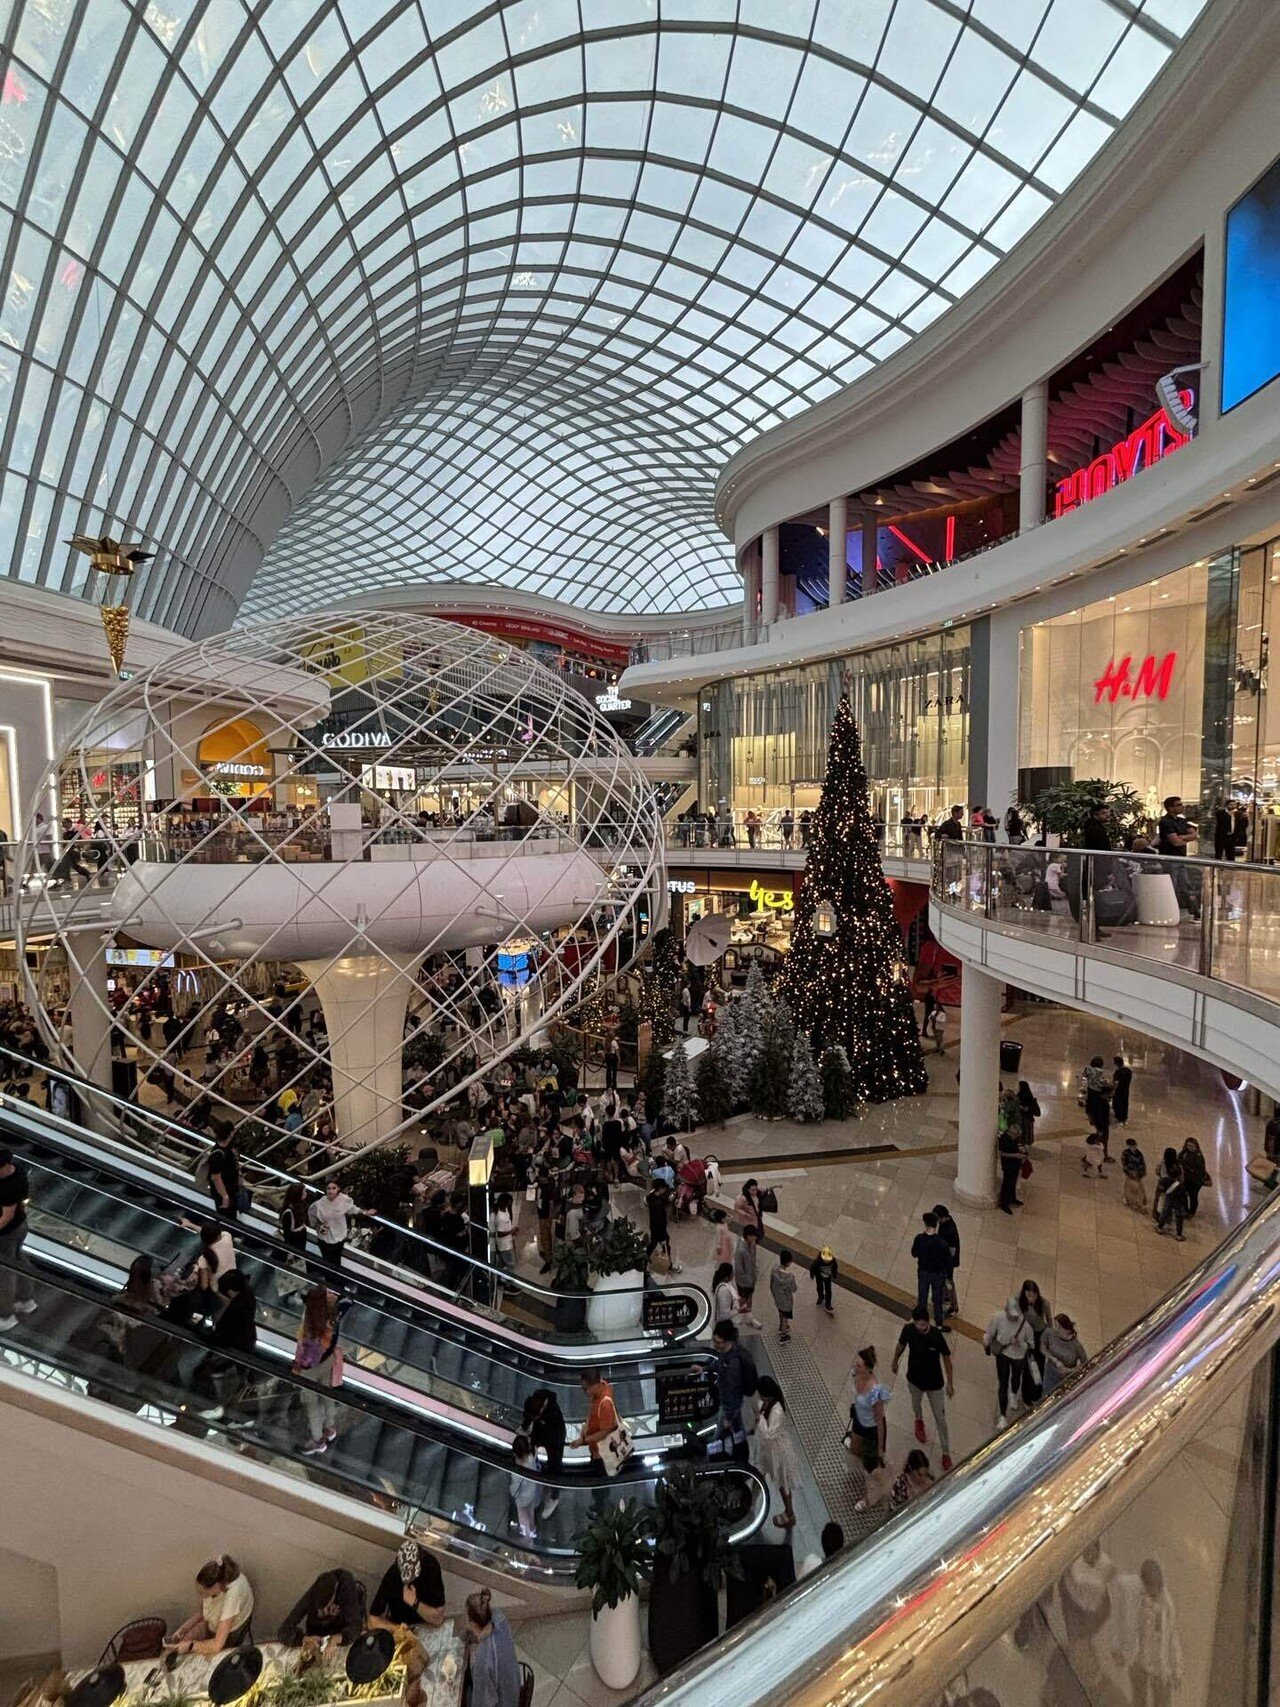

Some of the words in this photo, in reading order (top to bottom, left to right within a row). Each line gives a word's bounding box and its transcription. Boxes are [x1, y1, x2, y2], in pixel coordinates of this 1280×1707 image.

[1093, 651, 1177, 704] H&M
[924, 694, 964, 709] ZARA
[322, 732, 392, 748] GODIVA
